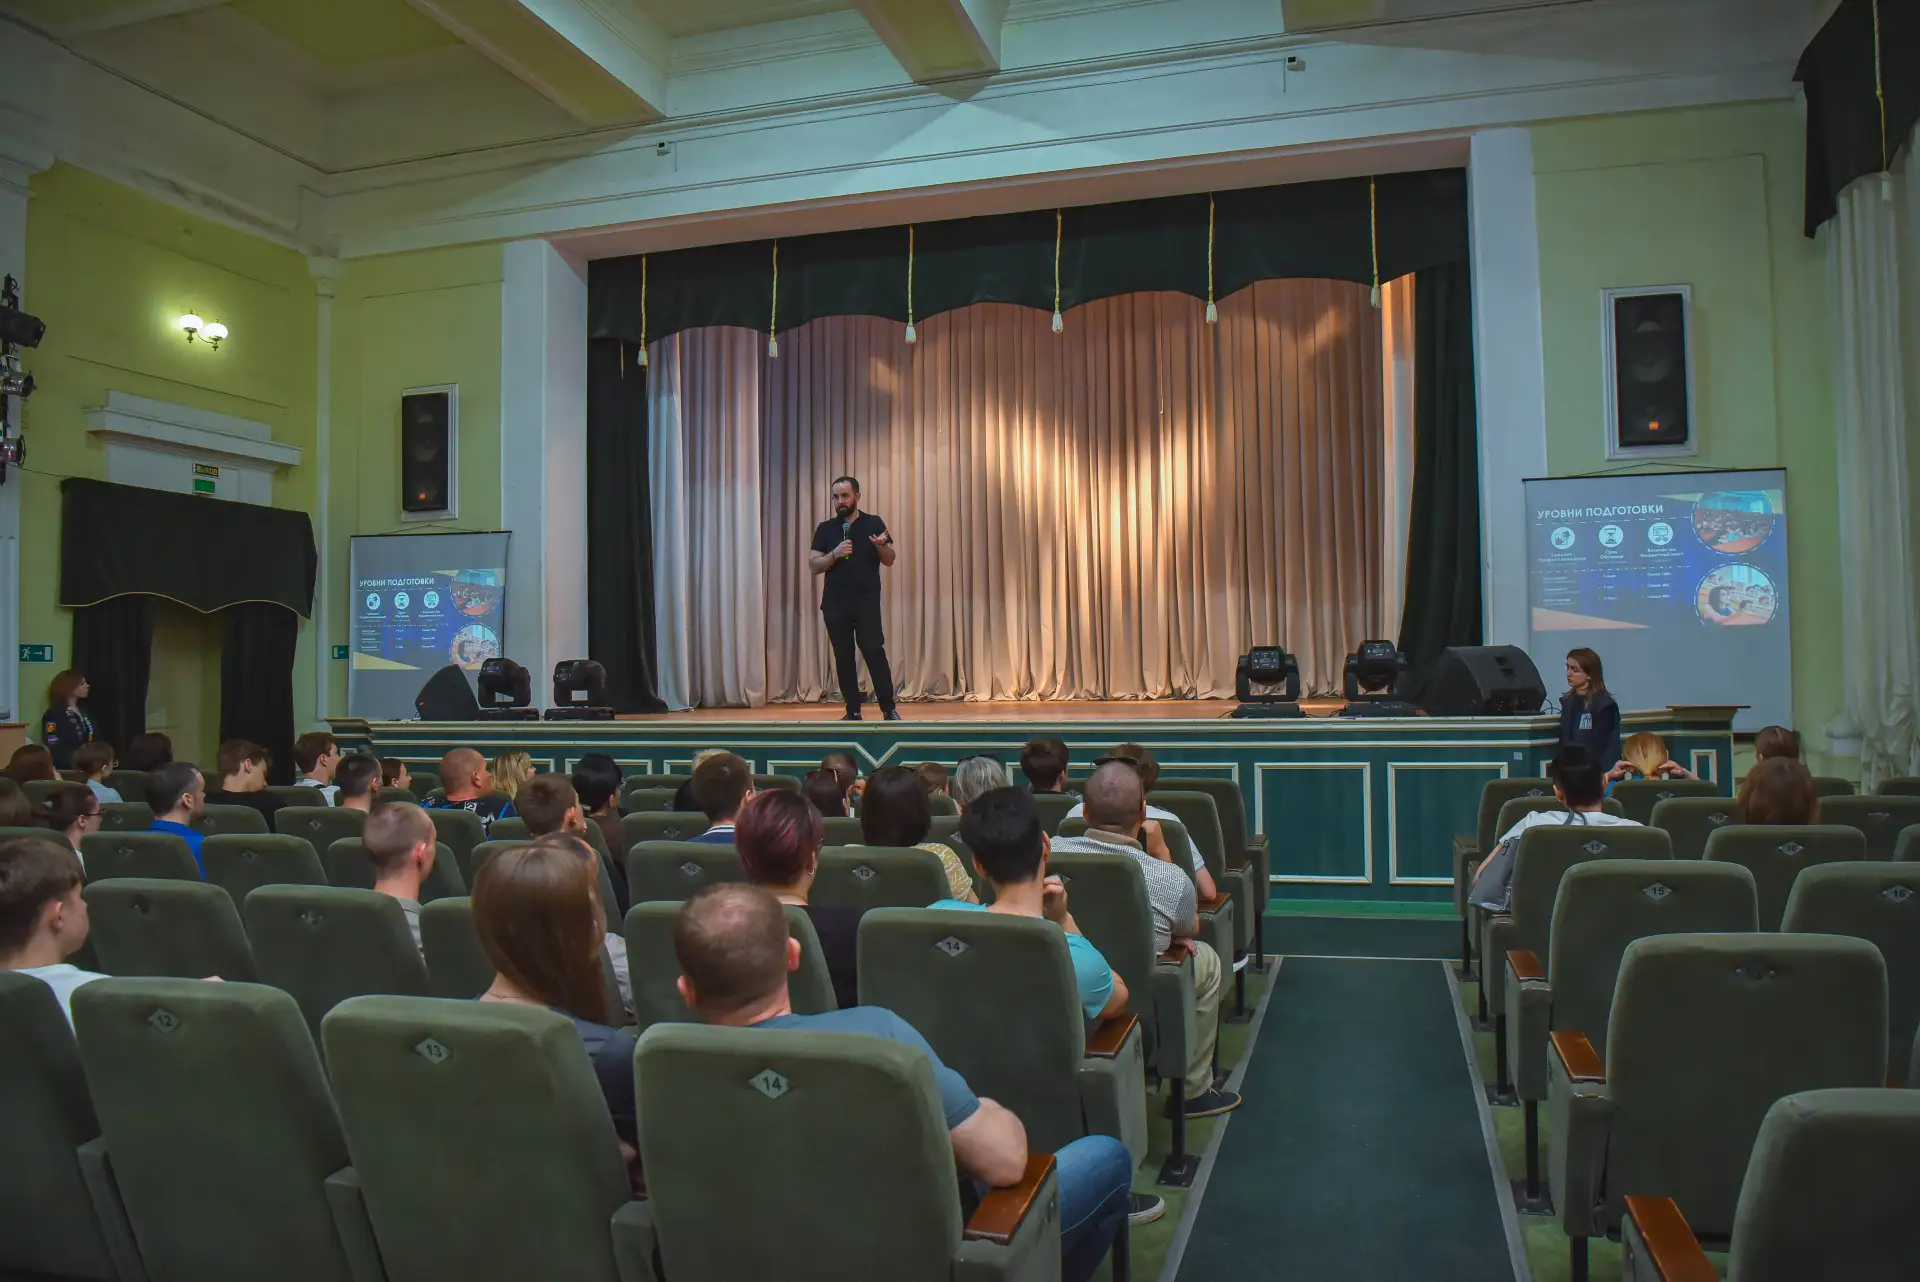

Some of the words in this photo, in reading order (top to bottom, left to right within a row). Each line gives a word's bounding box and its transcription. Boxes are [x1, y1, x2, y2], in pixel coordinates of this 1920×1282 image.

[1537, 508, 1582, 519] УРОВНИ
[1586, 504, 1664, 517] ПОДГОТОВКИ
[359, 579, 385, 587] УРОВНИ
[388, 577, 434, 586] ПОДГОТОВКИ
[1590, 843, 1601, 851] 15
[860, 868, 870, 877] 13
[1651, 887, 1665, 896] 15
[1892, 889, 1905, 898] 16
[945, 941, 960, 952] 14
[157, 1015, 173, 1027] 12
[426, 1044, 442, 1058] 13
[762, 1076, 781, 1091] 14
